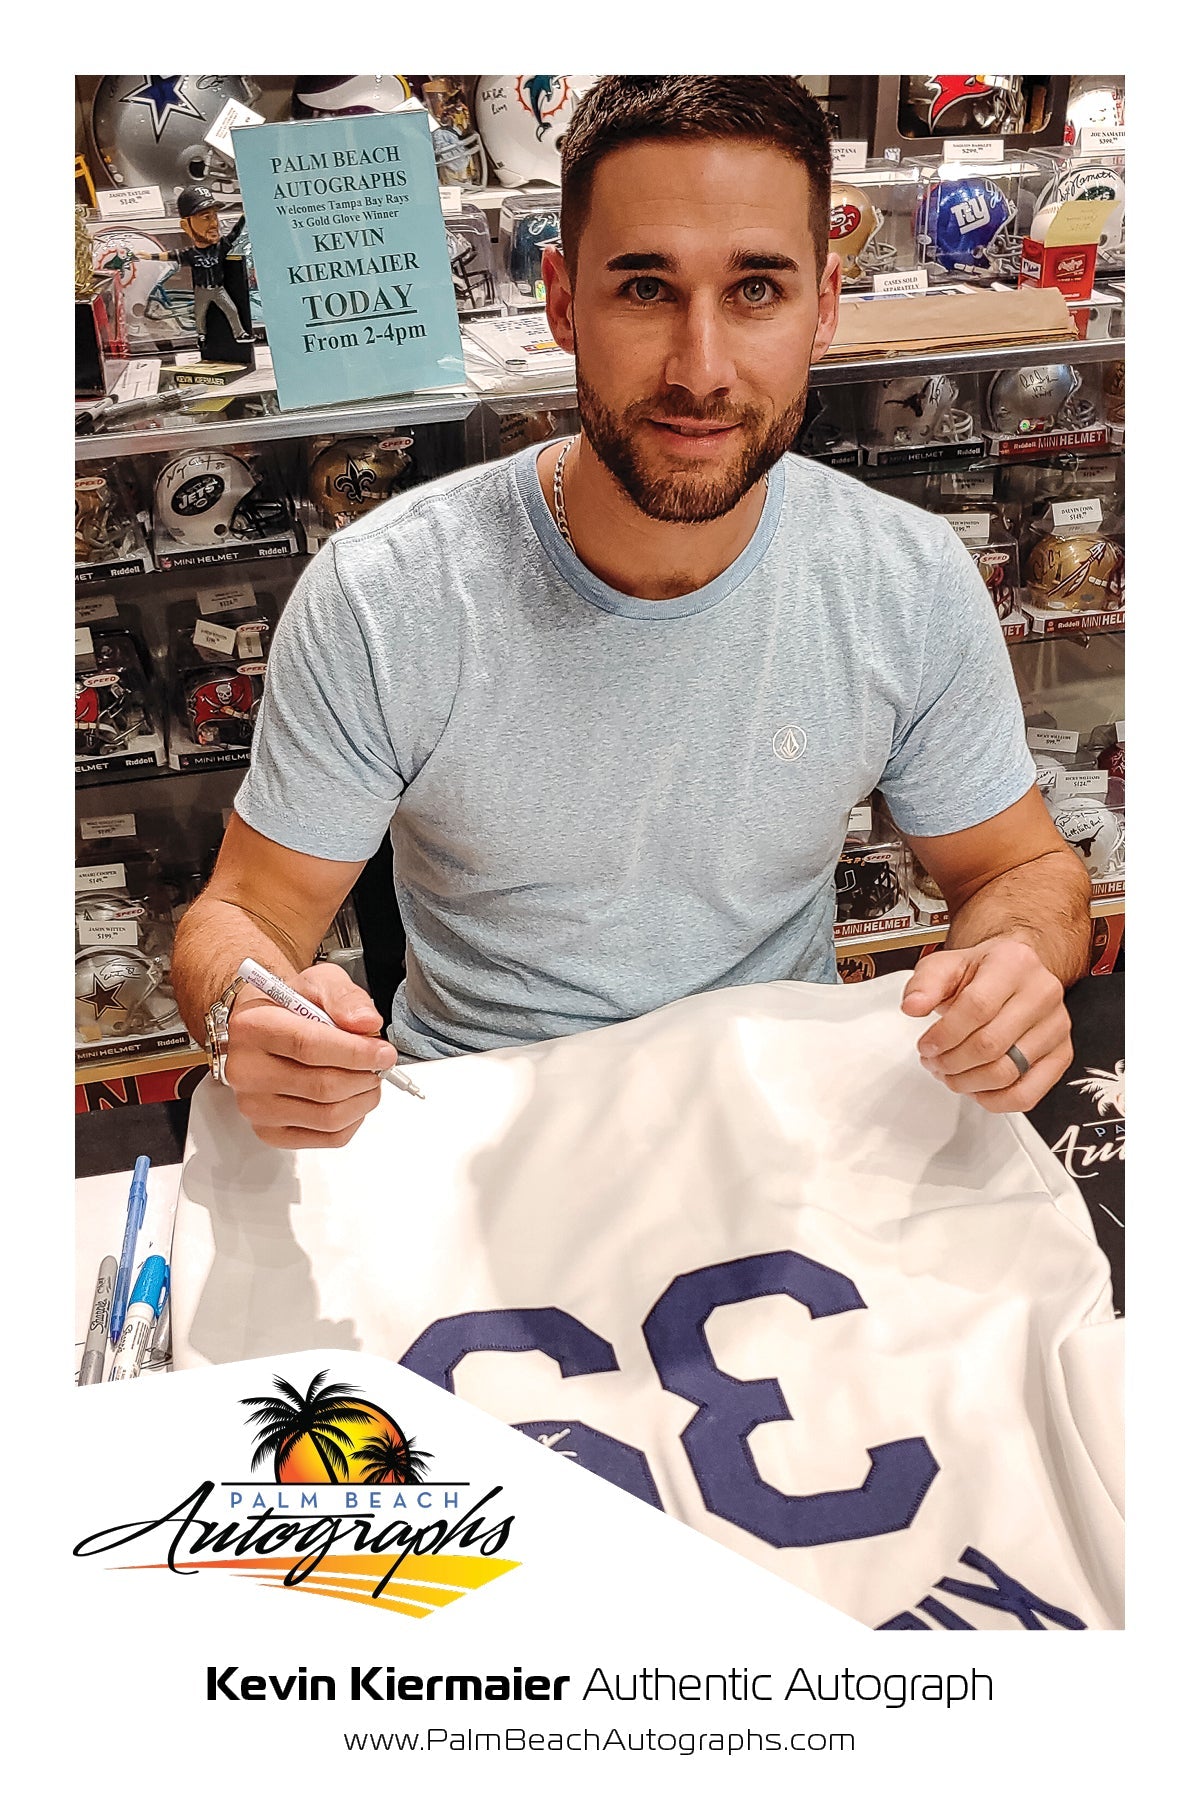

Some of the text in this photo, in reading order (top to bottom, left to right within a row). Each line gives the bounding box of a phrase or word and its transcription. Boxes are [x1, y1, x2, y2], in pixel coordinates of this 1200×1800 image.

[270, 145, 401, 174] PALM BEACH
[273, 170, 407, 200] AUTOGRAPHS
[276, 193, 410, 216] Welcomes Tampa Bay Rays
[292, 210, 399, 229] 3x Gold Glove Winner
[312, 227, 385, 253] KEVIN
[287, 252, 420, 285] KIERMAIER
[902, 276, 918, 284] SOLD
[302, 283, 415, 321] TODAY
[302, 323, 427, 354] From 2-4pm
[1038, 437, 1058, 449] MINI
[1059, 431, 1103, 447] HELMET
[908, 450, 944, 462] HELMET
[178, 483, 215, 511] JETS
[174, 546, 288, 567] MINI HELMET Riddell
[111, 565, 141, 577] Riddell
[1082, 616, 1100, 628] MINI
[125, 757, 154, 767] Riddell
[194, 756, 216, 765] MINI
[842, 917, 909, 936] MINI HELMET
[76, 1036, 186, 1060] MINI HELMET Riddell
